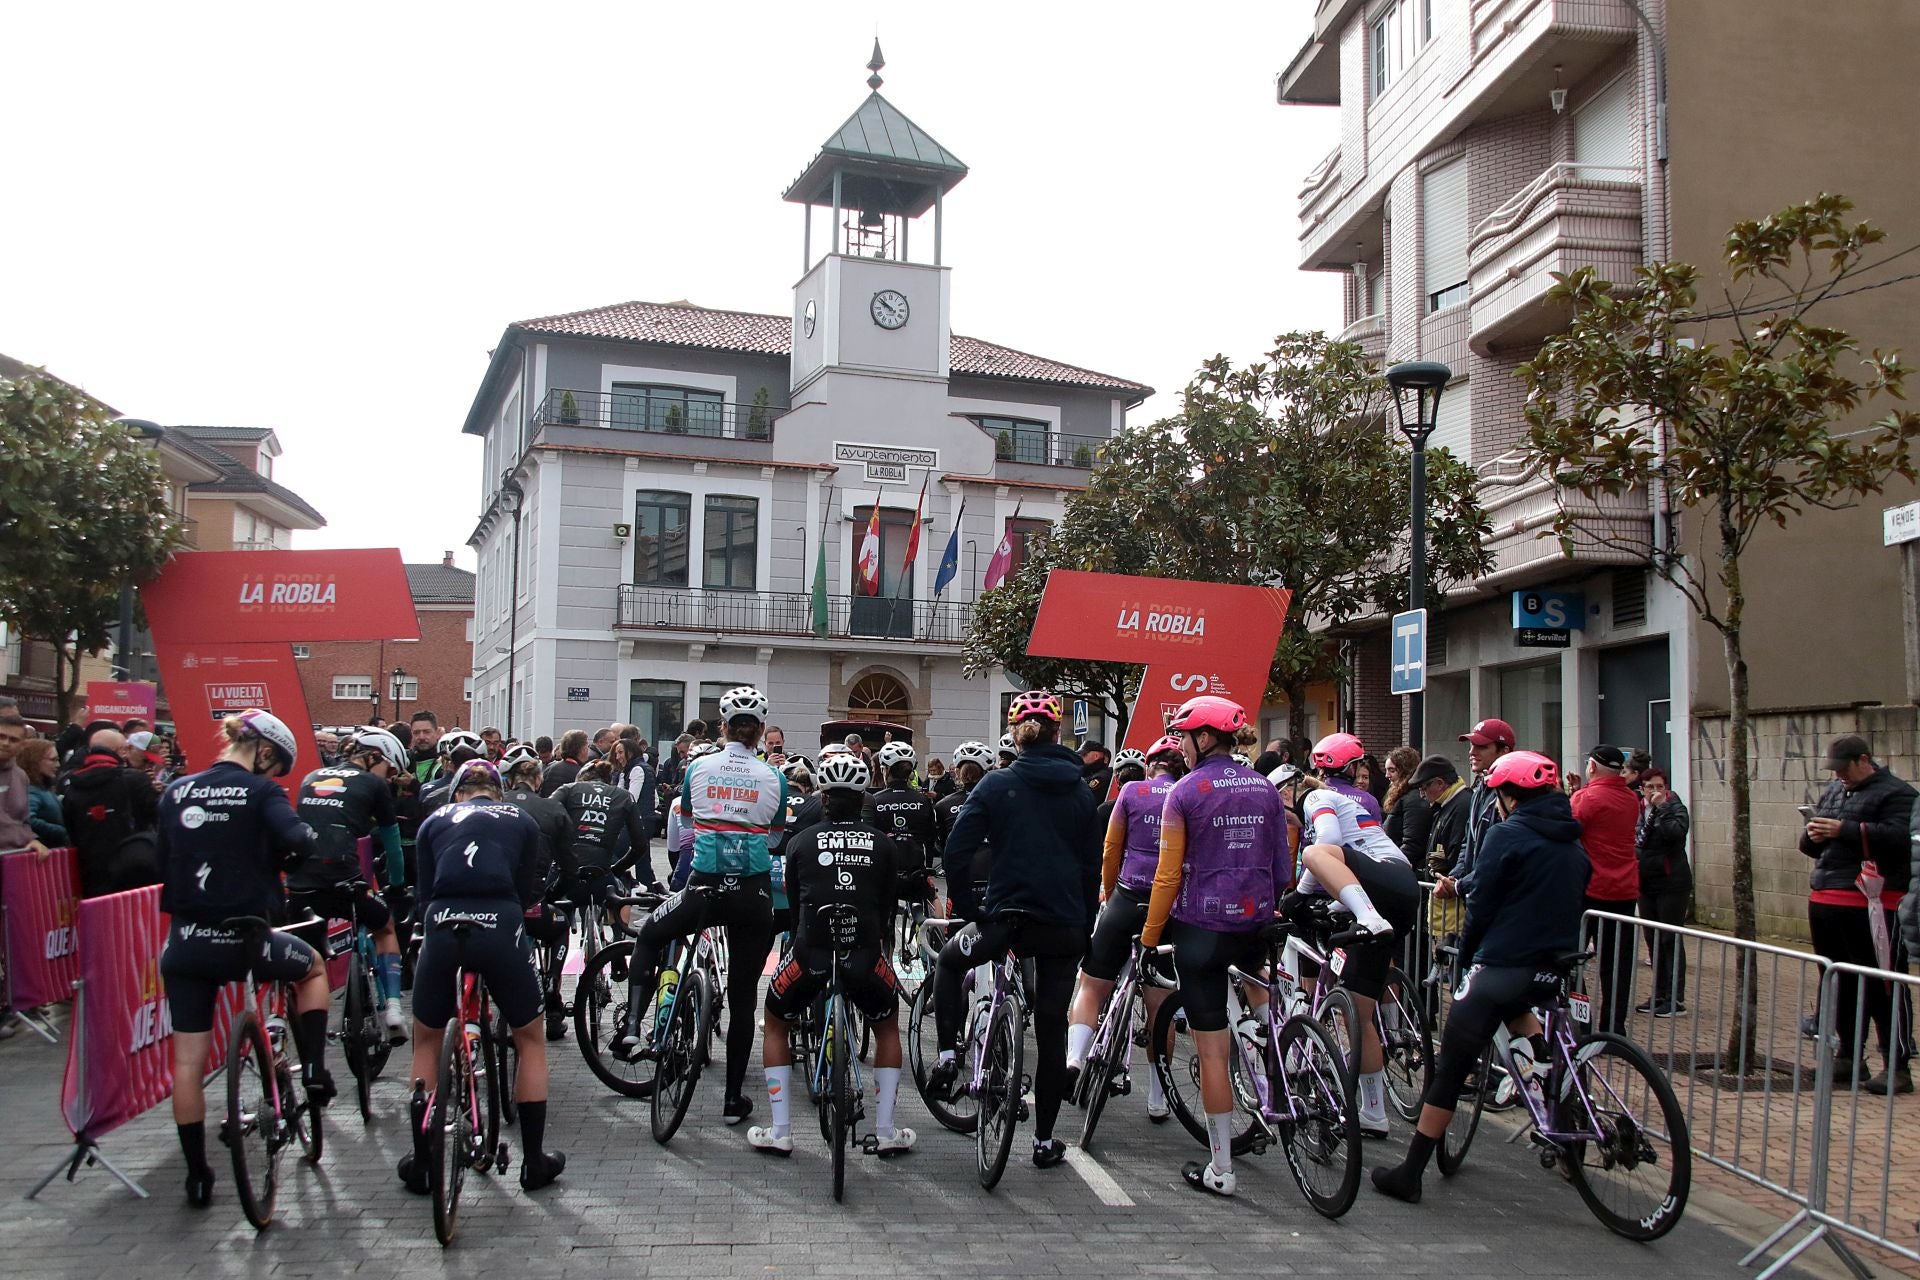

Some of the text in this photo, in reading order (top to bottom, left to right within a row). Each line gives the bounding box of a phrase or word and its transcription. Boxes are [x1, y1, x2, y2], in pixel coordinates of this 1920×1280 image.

[840, 447, 932, 463] Ayuntamiento
[869, 466, 902, 478] LA ROBLA
[239, 583, 336, 603] LA ROBLA
[1528, 598, 1566, 627] B S
[1117, 609, 1205, 636] LA ROBLA
[1537, 633, 1566, 641] ServiRed
[212, 686, 263, 699] LA VUELTA
[94, 704, 148, 714] ORGANIZACIÓN
[720, 765, 750, 774] neusus
[1213, 777, 1268, 788] BONGIOANNI
[581, 793, 612, 807] UAE
[707, 786, 759, 802] CM TEAM
[302, 797, 344, 808] REPSOL
[1226, 814, 1264, 826] imatra
[817, 838, 874, 850] CM TEAM
[46, 927, 70, 960] QUE
[1281, 980, 1292, 997] 186
[1575, 1002, 1588, 1020] 183
